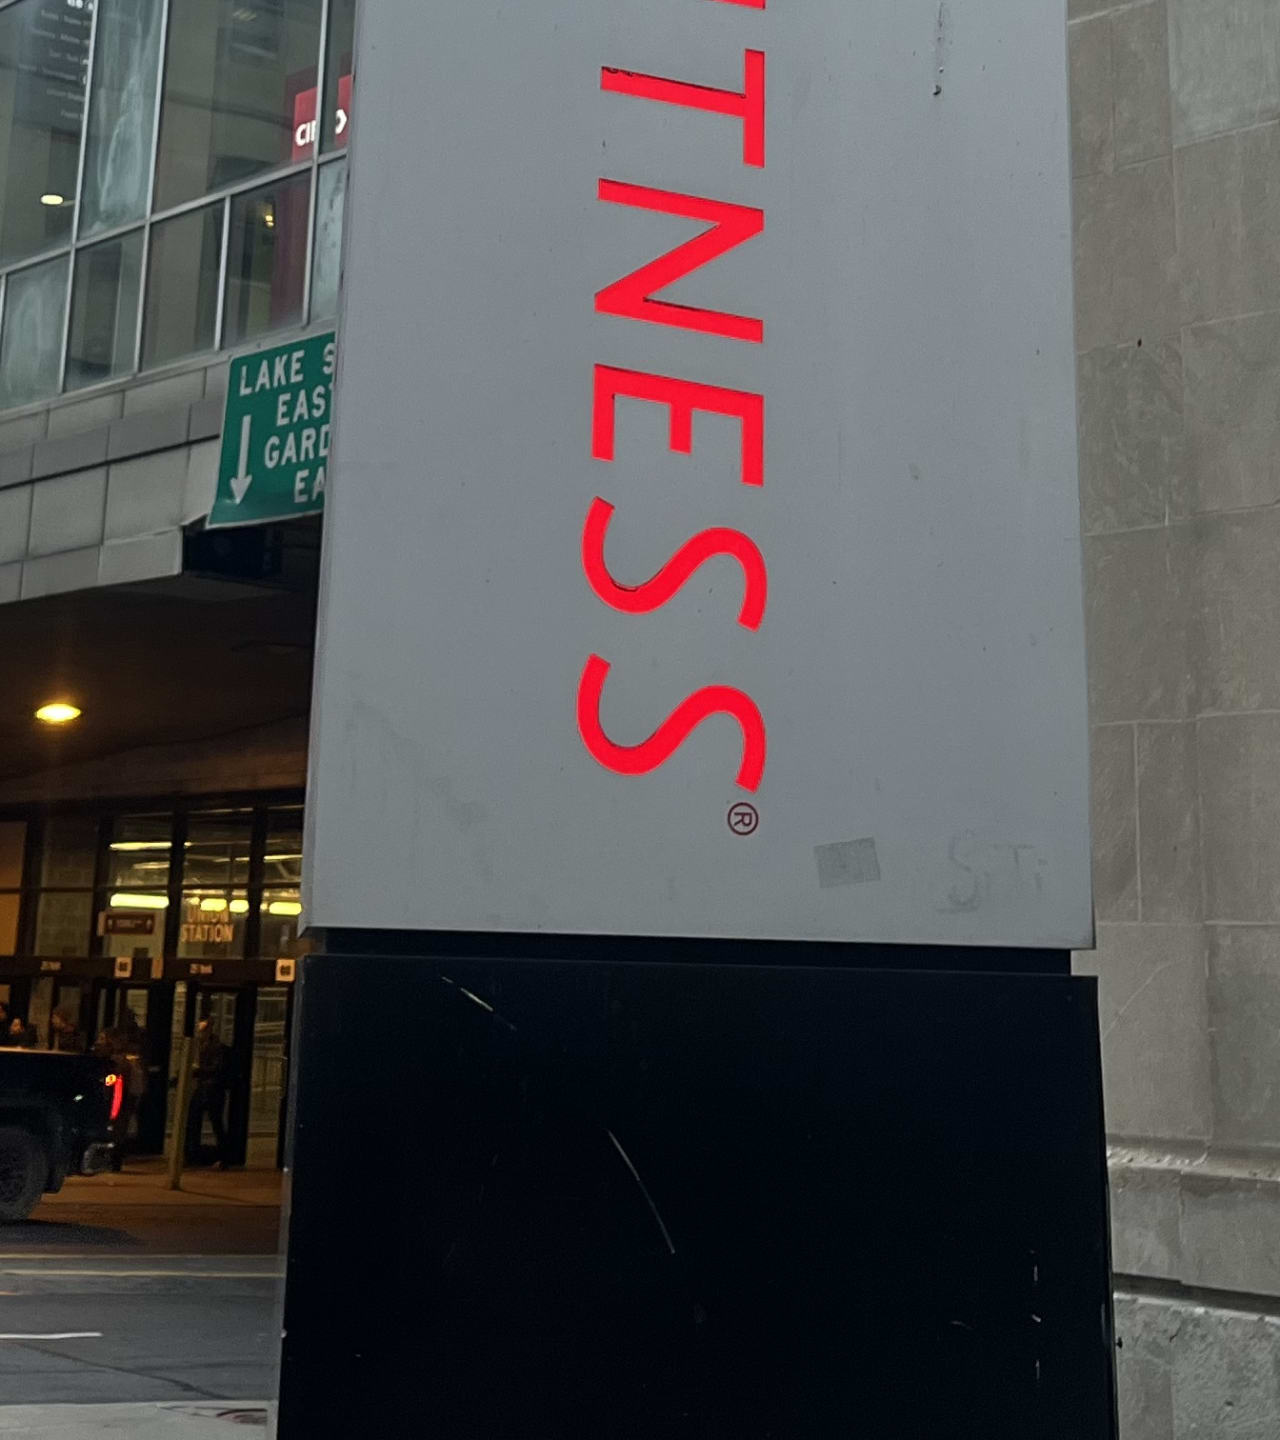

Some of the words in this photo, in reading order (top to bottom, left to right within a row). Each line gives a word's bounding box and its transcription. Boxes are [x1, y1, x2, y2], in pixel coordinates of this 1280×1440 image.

[239, 349, 306, 397] LAKE
[276, 383, 335, 427] EAS
[180, 923, 234, 943] STATION
